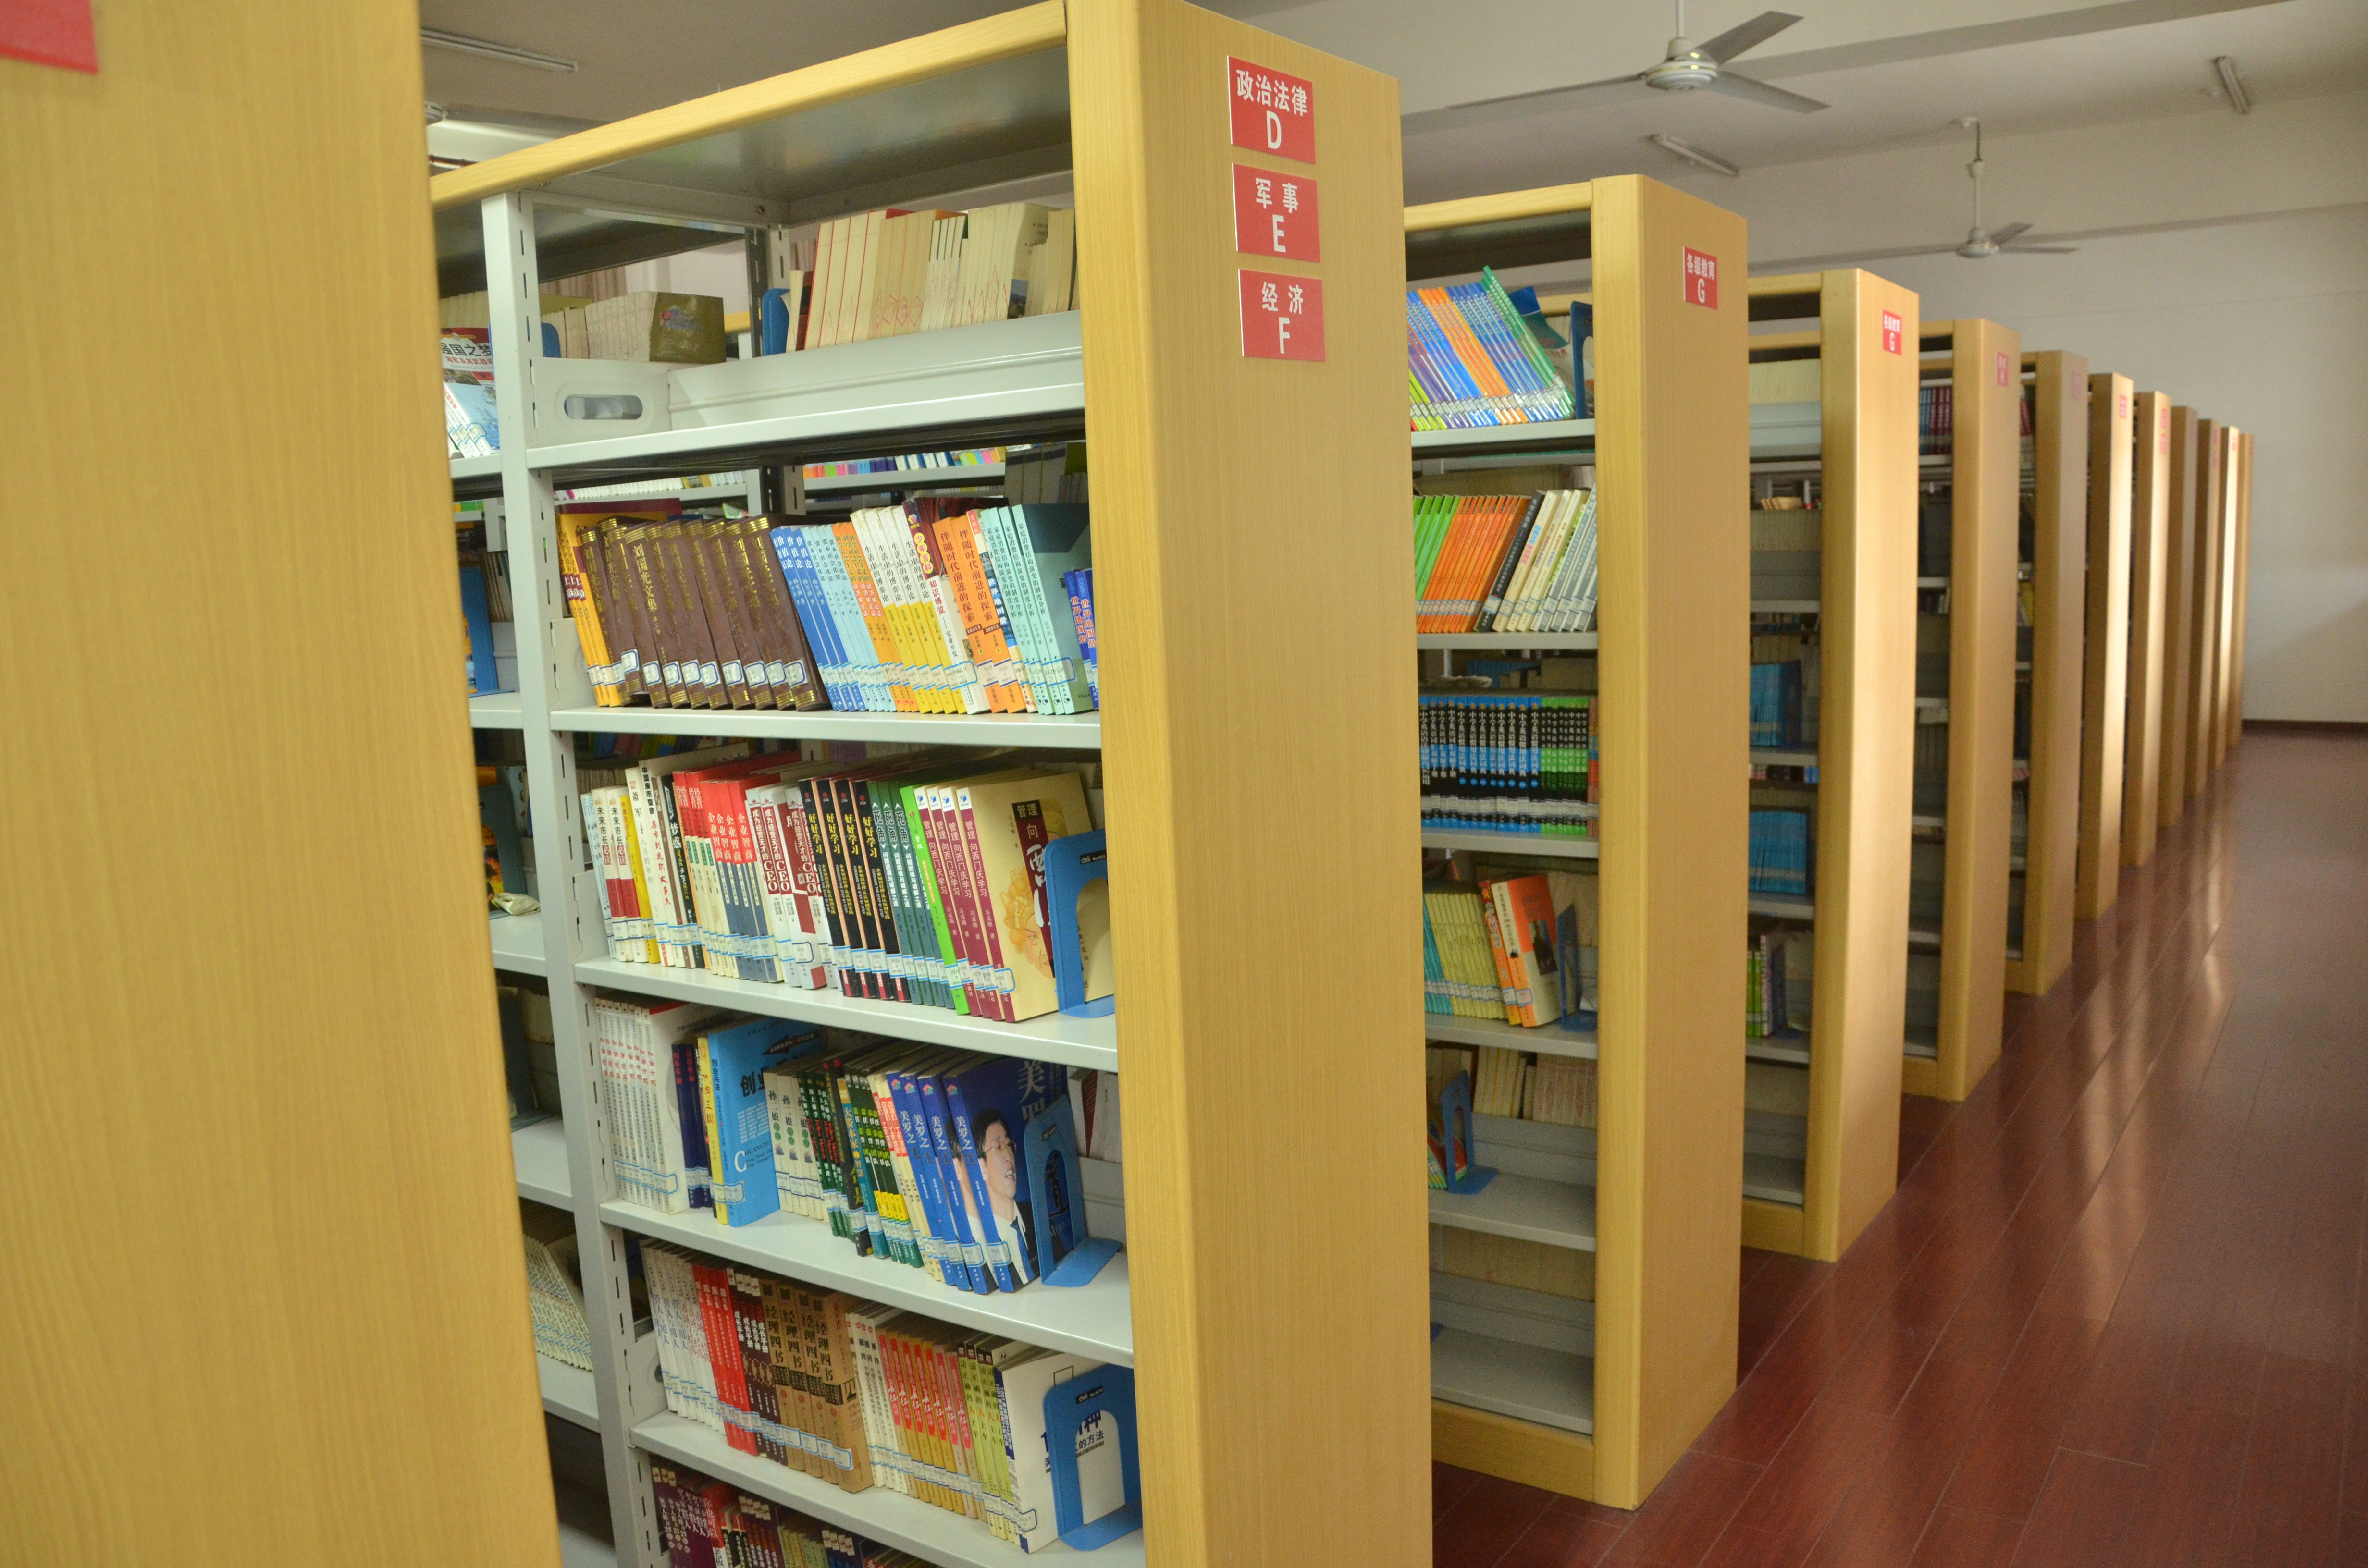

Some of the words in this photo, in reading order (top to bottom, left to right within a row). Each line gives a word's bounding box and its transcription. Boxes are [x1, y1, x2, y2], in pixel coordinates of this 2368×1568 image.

[1236, 69, 1308, 117] 政治法律
[1266, 111, 1282, 149] D
[1255, 177, 1299, 214] 军事
[1272, 214, 1286, 253] E
[1261, 281, 1304, 315] 经济
[1697, 278, 1706, 303] G
[1278, 316, 1290, 354] F
[777, 536, 794, 569] 价值论
[787, 536, 804, 569] 价值论
[796, 536, 813, 569] 价值论
[807, 540, 826, 582] 资本社会化论
[814, 540, 834, 582] 资本社会化论
[822, 539, 841, 580] 资本社会化论
[829, 539, 848, 581] 资本社会化论
[865, 545, 890, 602] 生活中的博弈论
[878, 544, 902, 602] 生活中的博弈论
[891, 542, 916, 600] 生活中的博弈论
[905, 540, 930, 599] 生活中的博弈论
[915, 534, 933, 572] 少年百科
[994, 526, 1024, 617] 家庭消费结构演变的制度分析
[1005, 525, 1035, 617] 家庭消费结构演变的制度分析
[1018, 523, 1046, 615] 家庭消费结构演变的制度分析
[633, 543, 658, 612] 刘国光文集
[929, 580, 946, 615] 知识博览
[940, 531, 975, 623] 伴随时代前进的探索
[960, 529, 994, 622] 伴随时代前进的探索
[1070, 595, 1087, 644] 世界地图册
[1081, 599, 1096, 648] 世界地图册
[808, 812, 823, 855] 好好学习
[826, 812, 841, 855] 好好学习
[873, 810, 886, 841] 死角
[884, 810, 897, 842] 死角
[896, 811, 909, 842] 死角
[923, 820, 934, 839] 管理
[936, 821, 947, 840] 管理
[965, 821, 976, 840] 管理
[1017, 803, 1038, 819] 管理
[596, 806, 612, 865] 未来市长必读
[611, 806, 627, 865] 未来市长必读
[708, 812, 723, 859] 企业智商
[716, 813, 732, 860] 企业智商
[726, 814, 742, 862] 企业智商
[738, 812, 753, 861] 企业智商
[844, 813, 859, 855] 好好学习
[863, 816, 878, 858] 好好学习
[928, 842, 947, 895] 向西门庆学习
[941, 842, 960, 896] 向西门庆学习
[948, 822, 960, 841] 管理
[954, 844, 972, 898] 向西门庆学习
[970, 843, 987, 897] 向西门庆学习
[711, 1058, 721, 1091] 创业兵法
[765, 1305, 784, 1364] 经理四书
[783, 1309, 802, 1369] 经理四书
[801, 1314, 820, 1374] 经理四书
[816, 1322, 834, 1382] 经理四书
